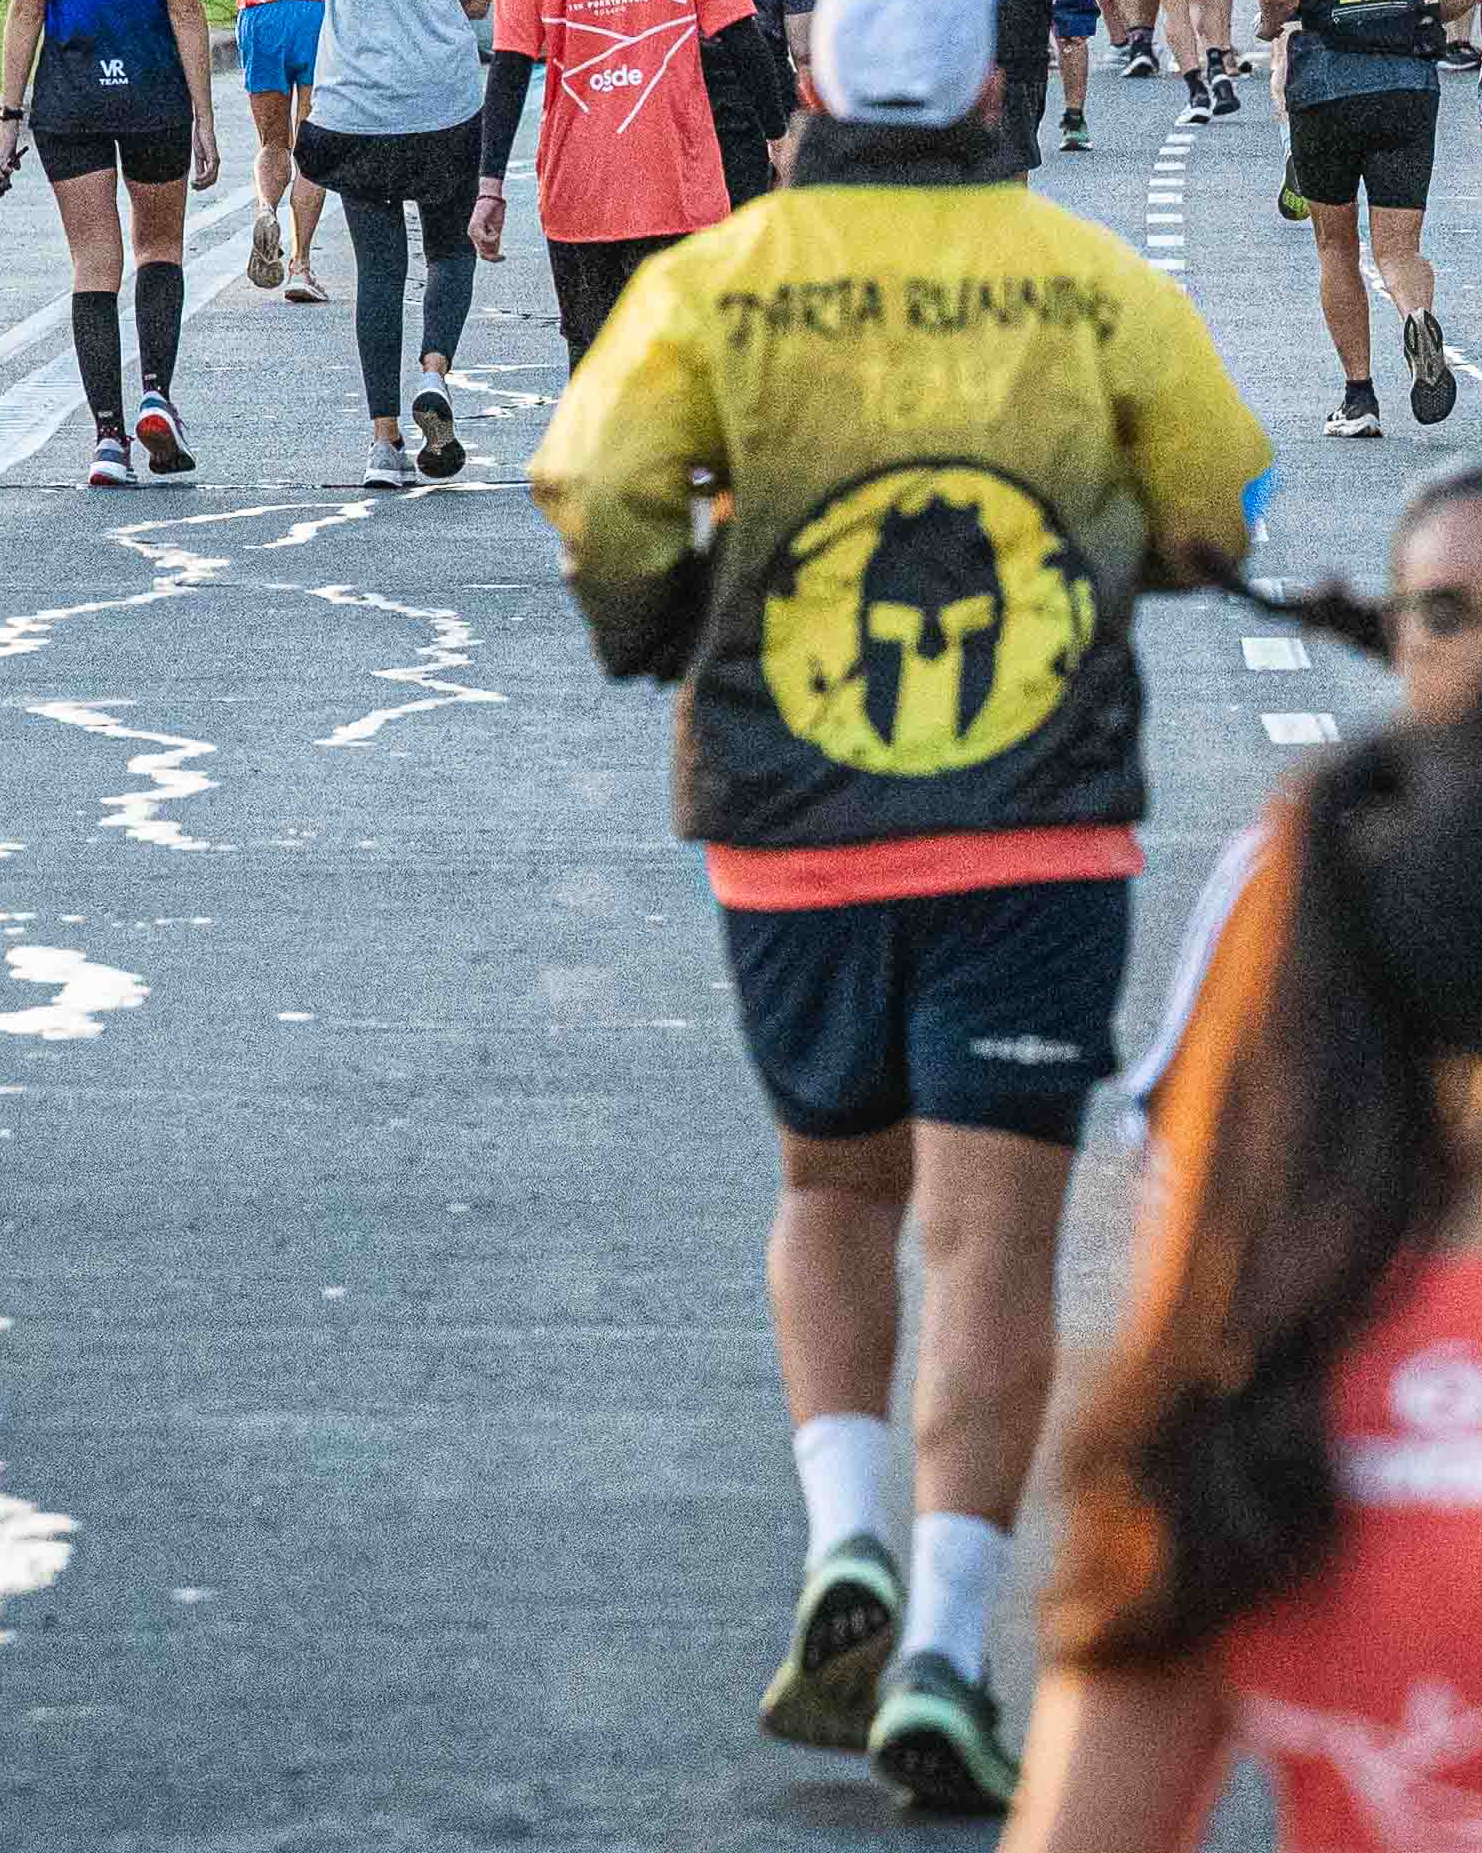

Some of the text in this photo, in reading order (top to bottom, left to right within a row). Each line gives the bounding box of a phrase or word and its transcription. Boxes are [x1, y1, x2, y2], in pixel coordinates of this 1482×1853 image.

[100, 59, 126, 78] VR
[99, 77, 129, 86] TEAM
[590, 64, 643, 93] osde
